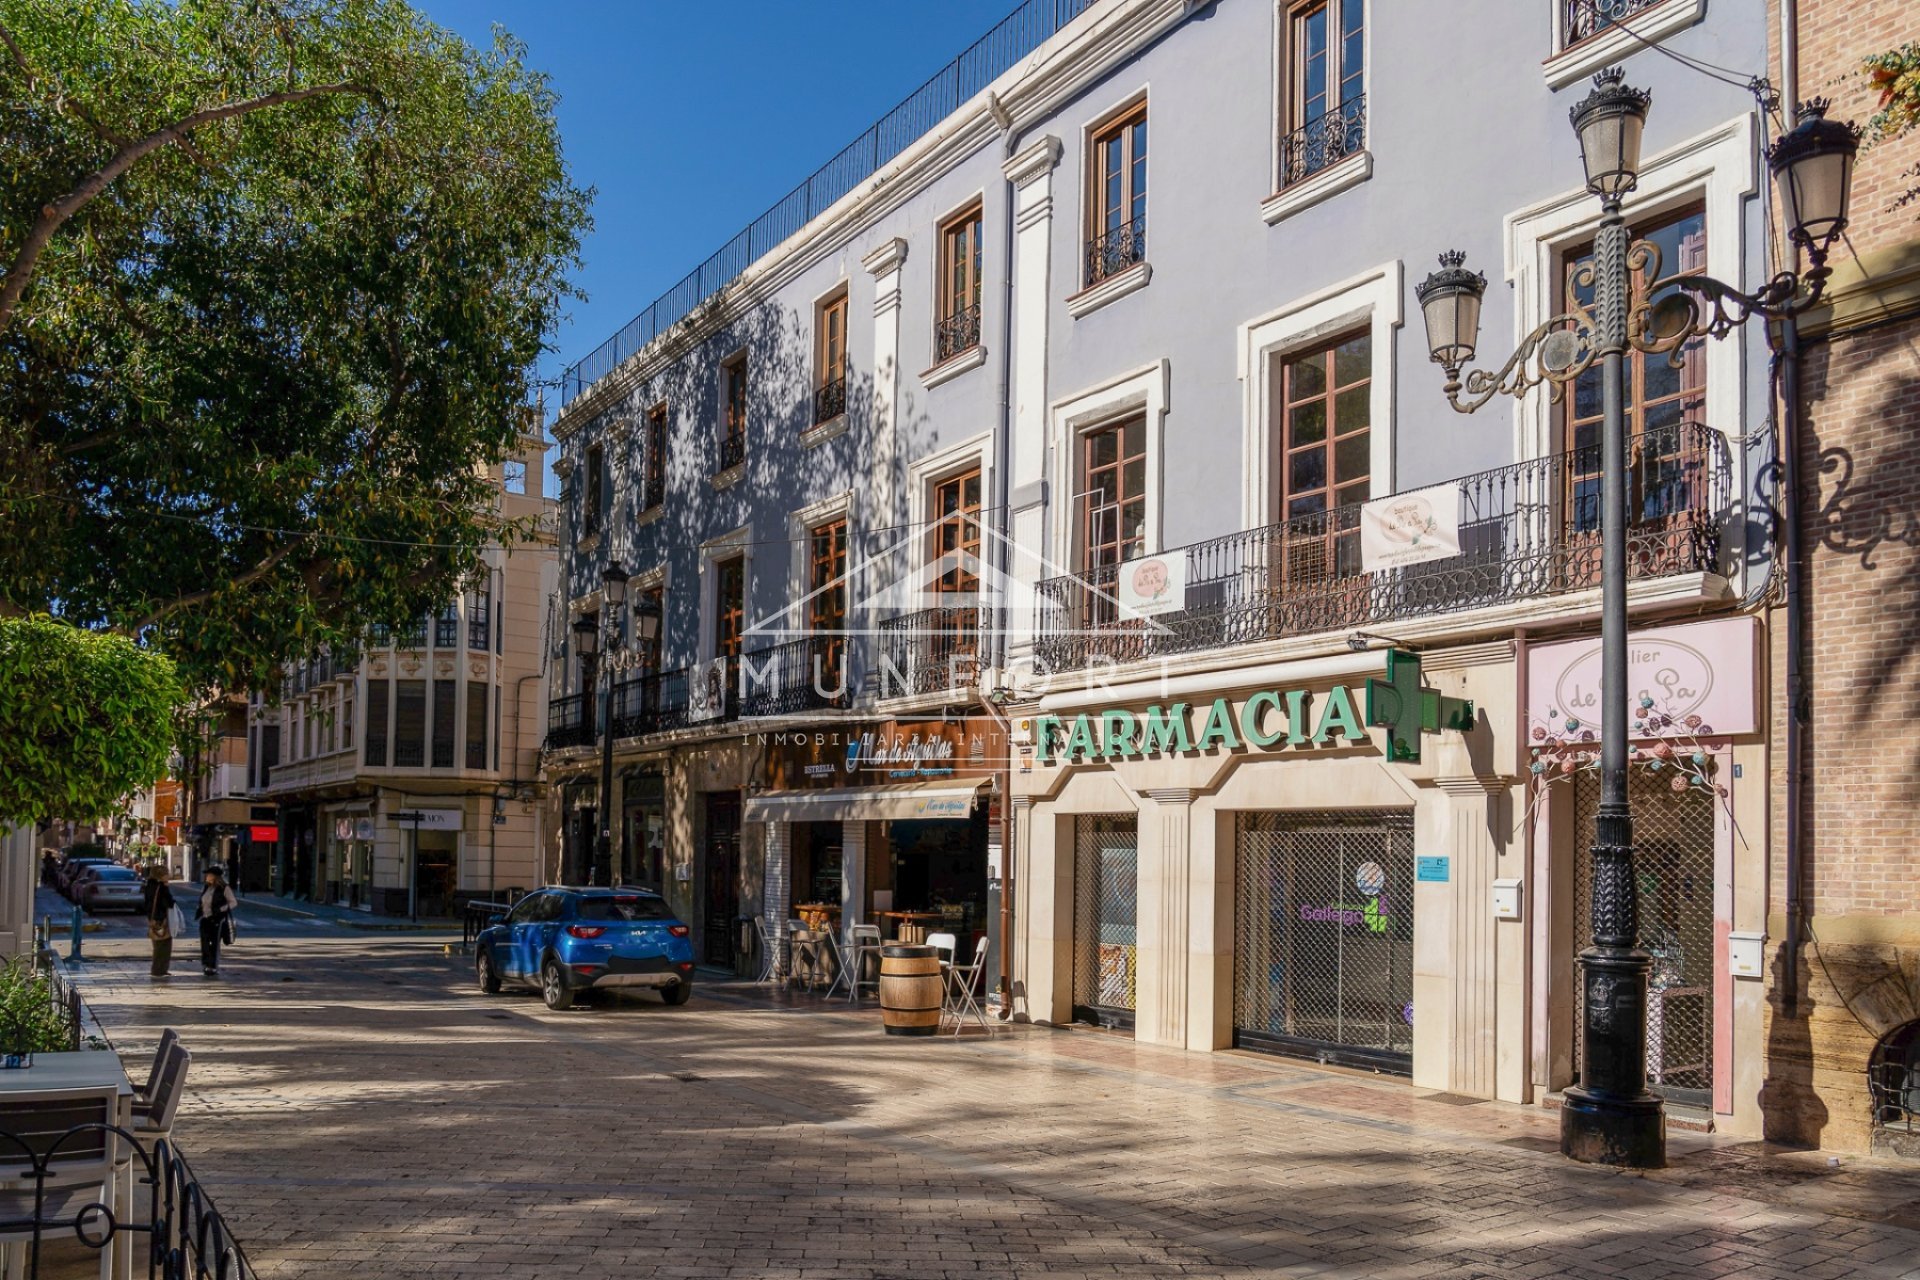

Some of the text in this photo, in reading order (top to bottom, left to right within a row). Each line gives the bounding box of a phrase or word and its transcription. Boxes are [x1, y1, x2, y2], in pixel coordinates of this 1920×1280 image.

[1631, 649, 1661, 664] lier
[1570, 684, 1597, 708] de
[1036, 686, 1365, 761] FARMACIA
[803, 763, 836, 774] ESTRELLA
